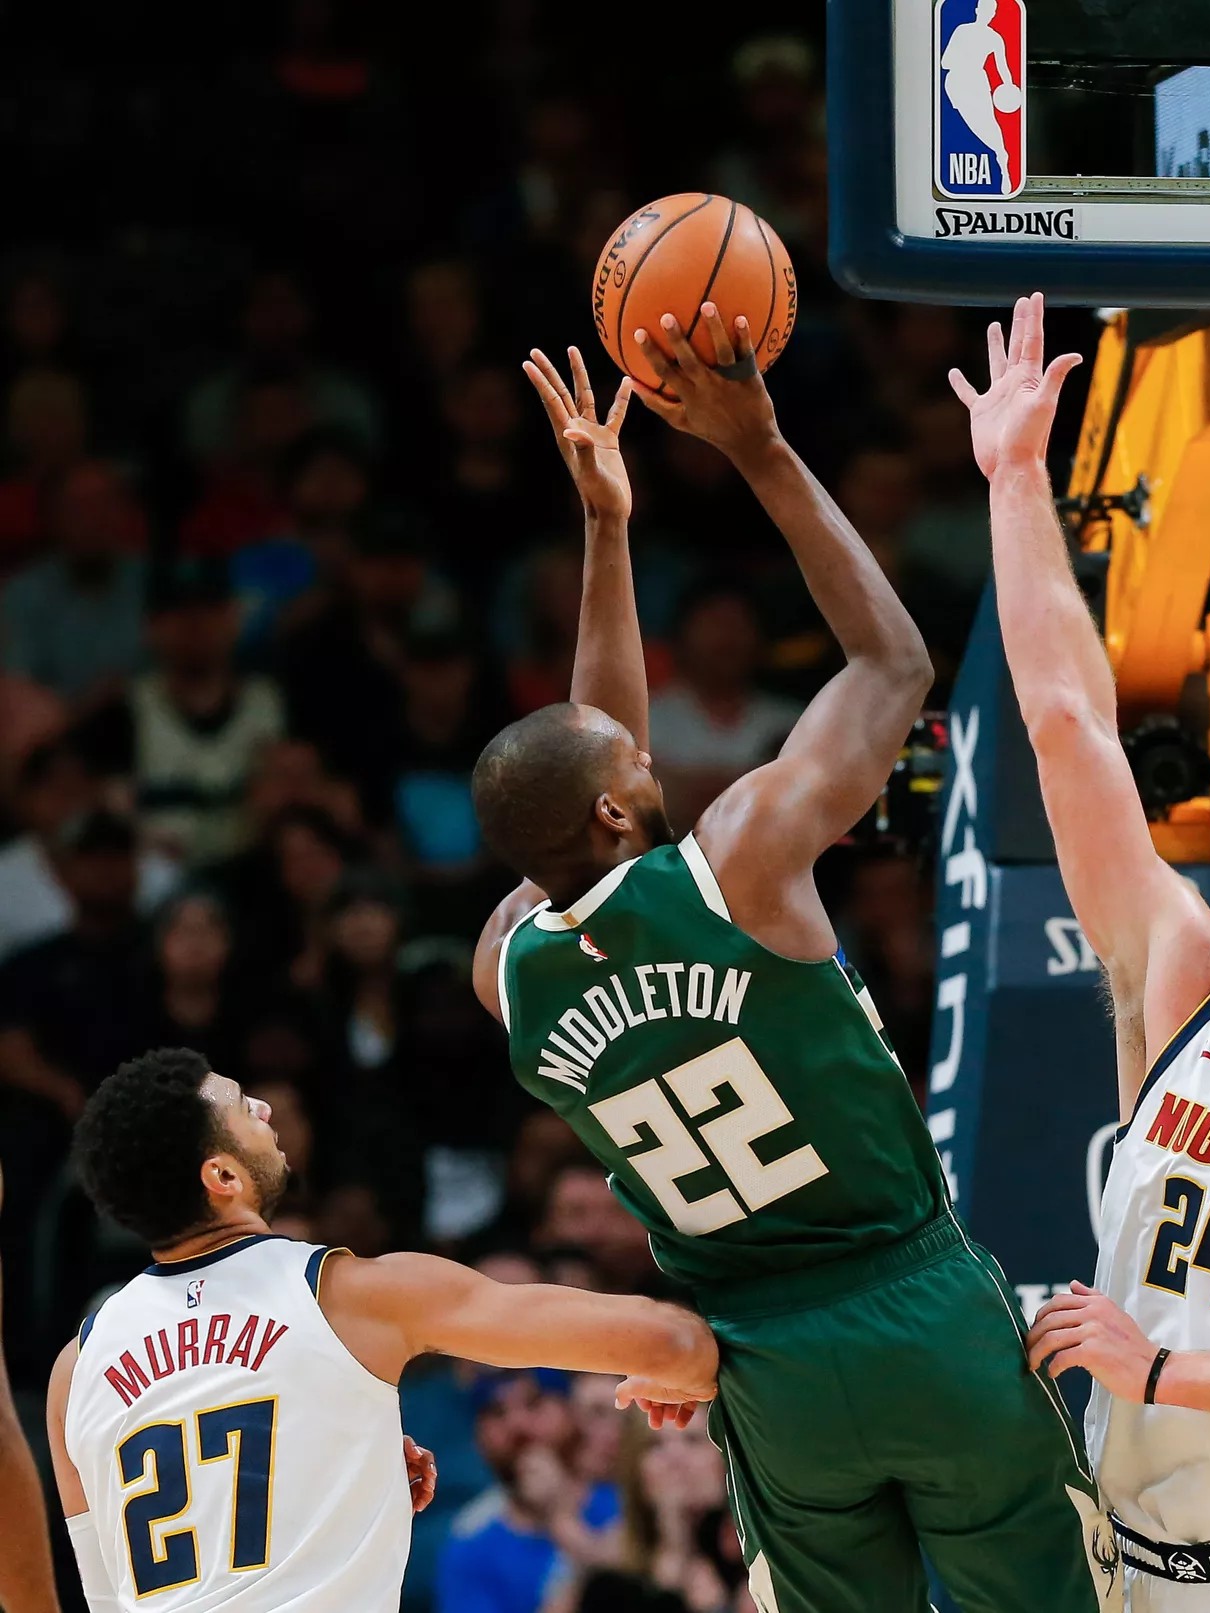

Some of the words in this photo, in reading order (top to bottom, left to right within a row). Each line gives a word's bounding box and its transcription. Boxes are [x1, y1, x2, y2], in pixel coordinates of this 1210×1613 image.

[935, 207, 1075, 241] SPALDING
[950, 153, 992, 185] NBA
[537, 962, 752, 1095] MIDDLETON
[587, 1036, 830, 1237] 22
[103, 1313, 290, 1409] MURRAY
[115, 1394, 280, 1602] 27
